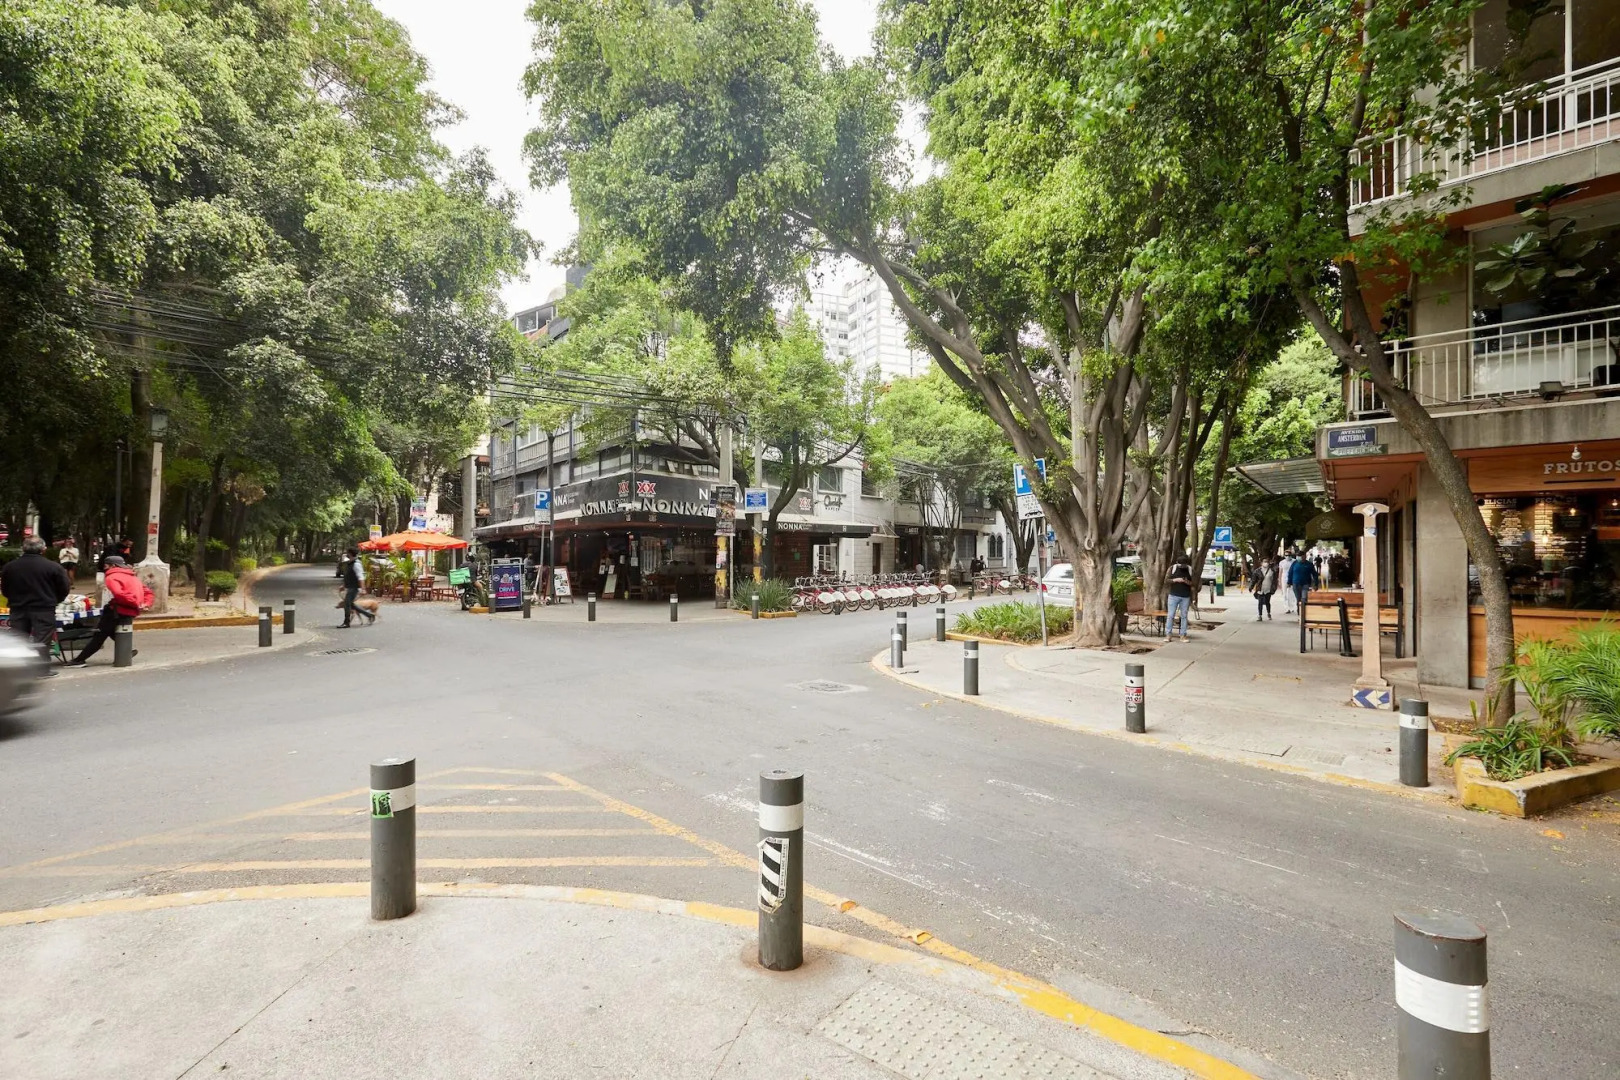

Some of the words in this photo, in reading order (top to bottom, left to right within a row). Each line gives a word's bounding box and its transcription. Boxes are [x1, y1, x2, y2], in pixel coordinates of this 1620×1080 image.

[1338, 434, 1366, 443] AMSTERDAM
[537, 491, 548, 506] P
[553, 495, 568, 507] NNA
[580, 500, 613, 516] NONNA
[642, 498, 710, 516] NONNA
[778, 522, 803, 530] NONNA
